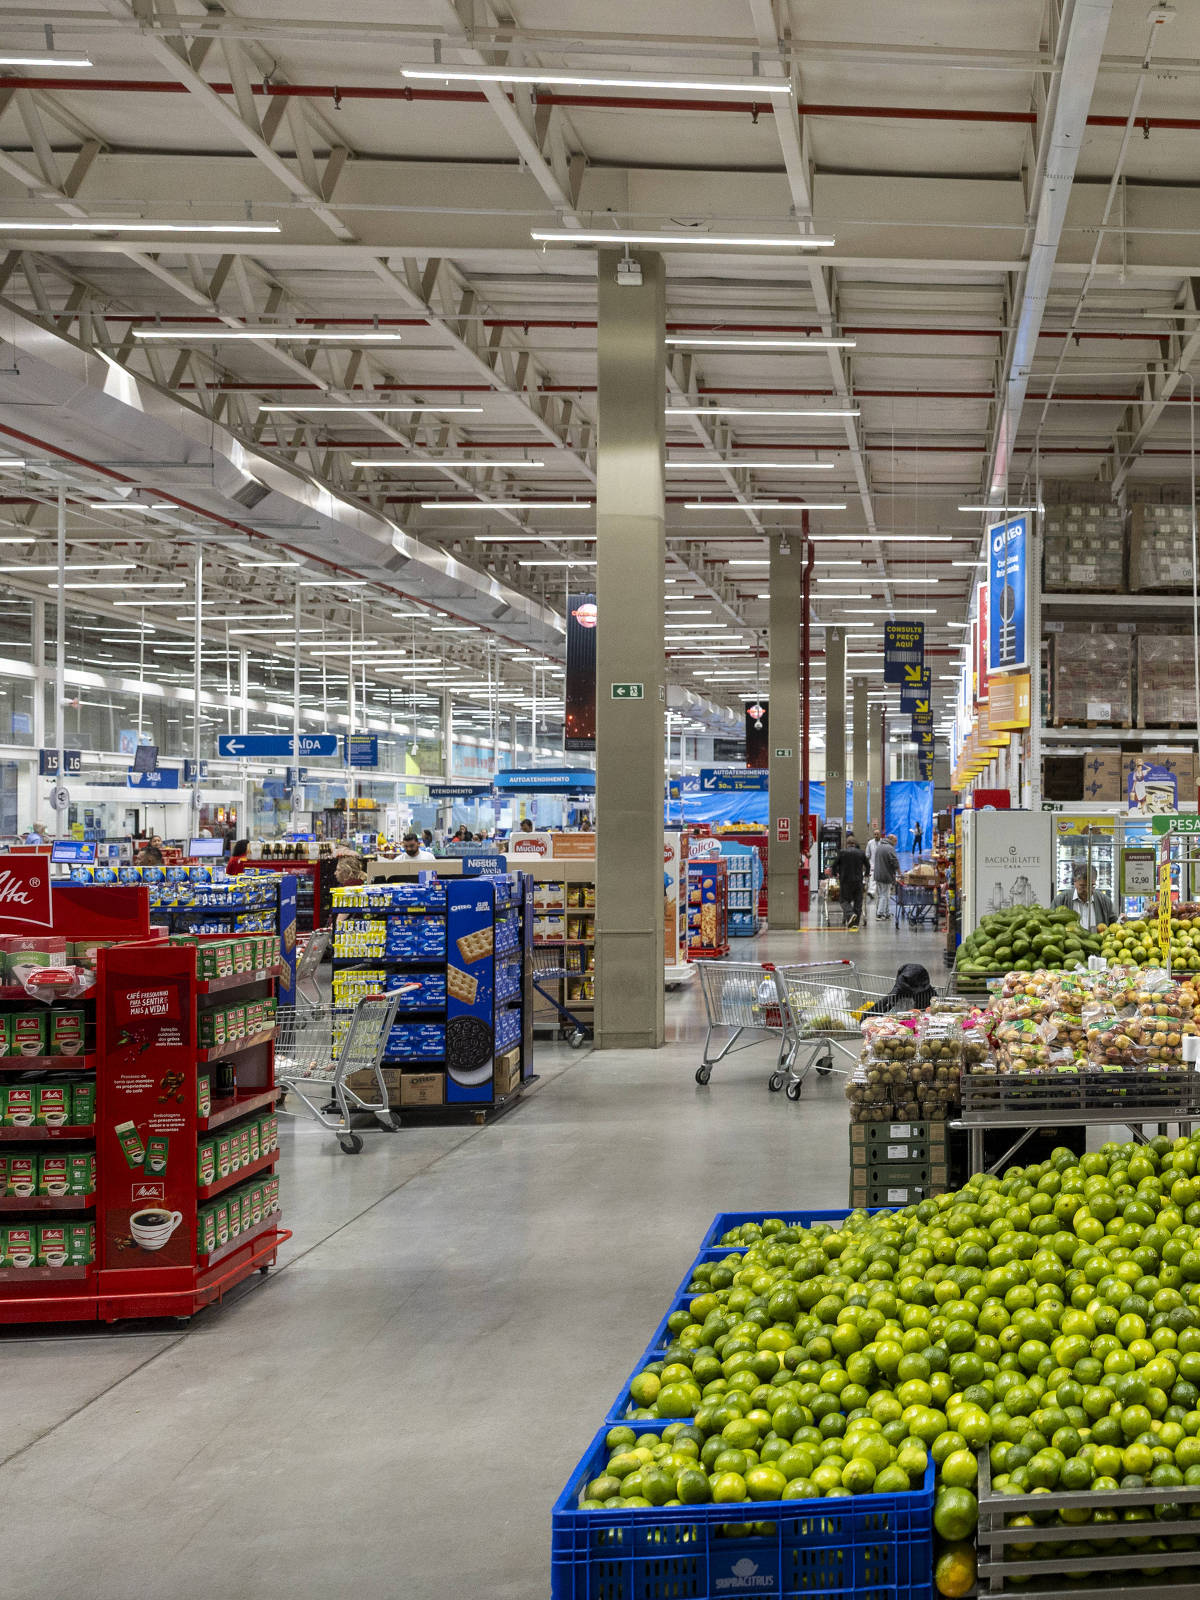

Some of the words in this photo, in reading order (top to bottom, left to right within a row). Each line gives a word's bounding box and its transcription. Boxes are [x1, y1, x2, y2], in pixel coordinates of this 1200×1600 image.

[897, 634, 919, 642] PREÇO
[47, 756, 58, 769] 15
[69, 757, 81, 769] 16
[515, 844, 546, 854] Mucilon
[467, 858, 498, 868] Nestlé
[1131, 876, 1150, 885] 12,90
[450, 904, 472, 912] OREO
[126, 991, 140, 1000] CAFÉ
[142, 997, 164, 1006] SENTIR
[130, 1007, 144, 1015] MAIS
[150, 1004, 169, 1013] VIDA!
